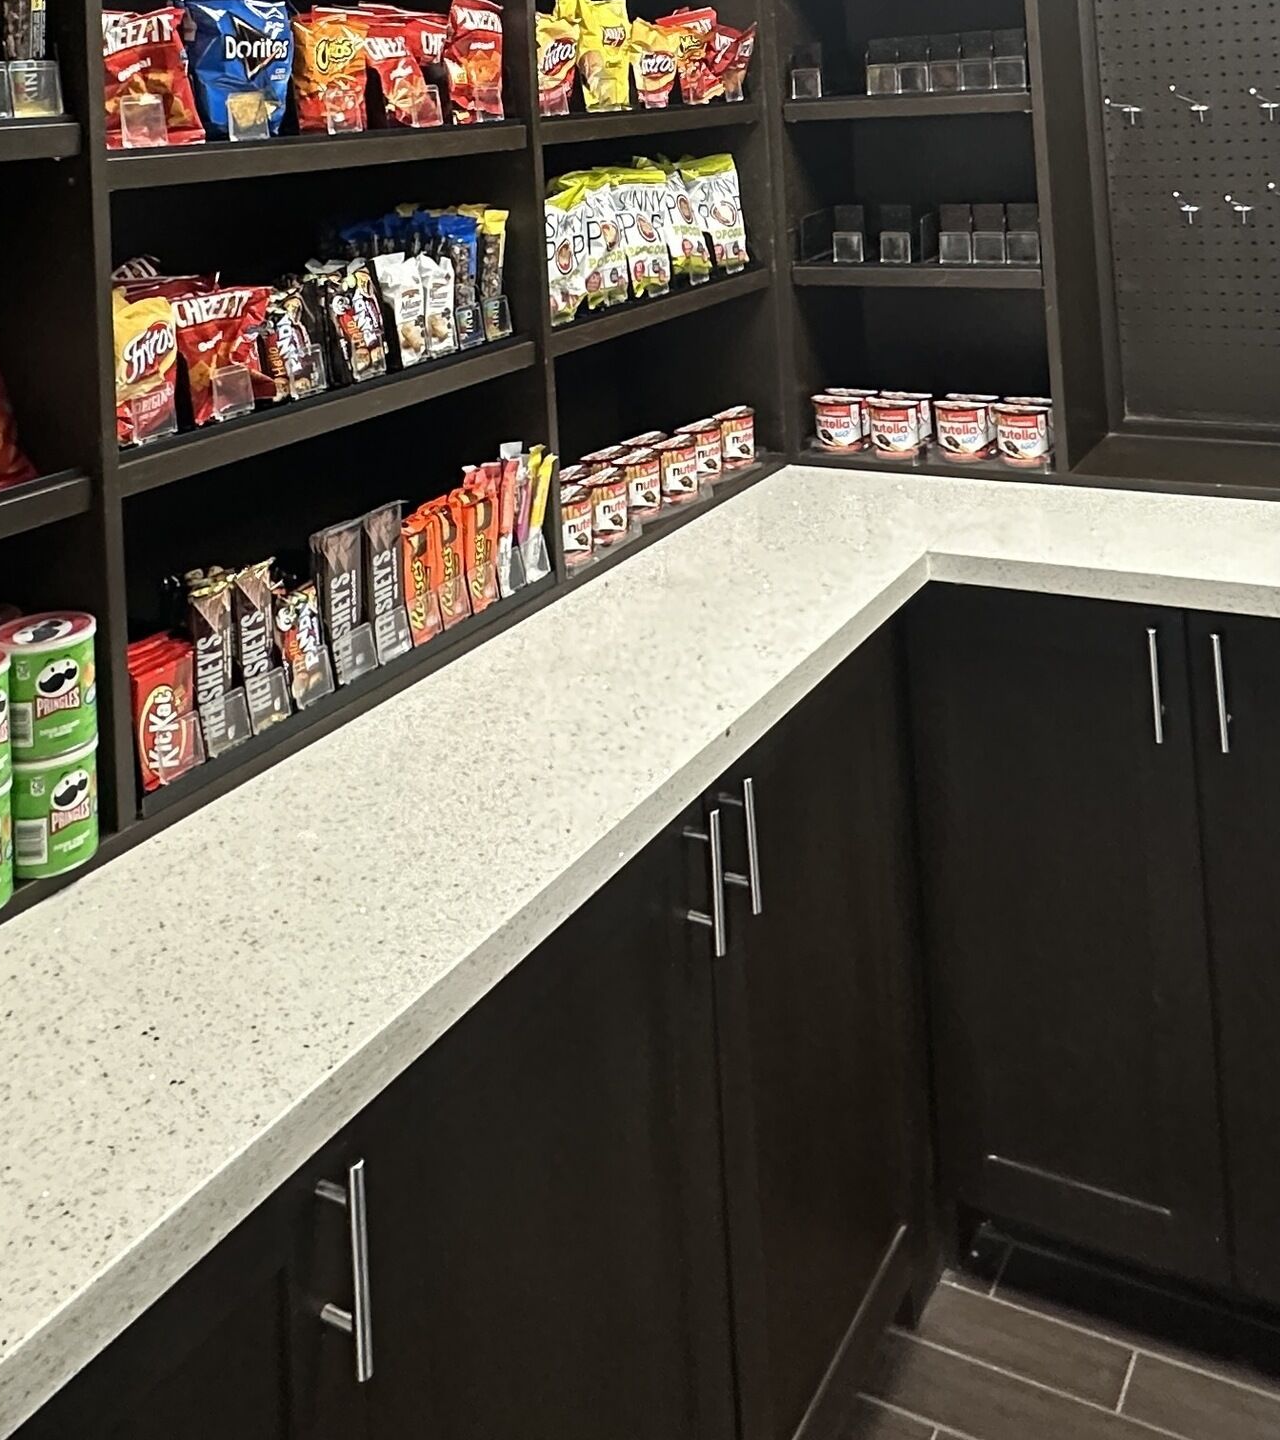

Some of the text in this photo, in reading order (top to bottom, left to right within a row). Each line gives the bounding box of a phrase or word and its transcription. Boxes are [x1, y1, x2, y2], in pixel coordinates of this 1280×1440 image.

[225, 36, 289, 60] Doritos
[352, 288, 380, 348] PANDA
[124, 325, 175, 385] Fritos
[276, 313, 303, 373] PANDA
[872, 422, 908, 434] nutella
[940, 424, 978, 436] nutella
[999, 429, 1038, 442] nutella
[296, 601, 320, 671] PANDA
[37, 687, 80, 719] PRINGLES
[51, 797, 91, 833] PRINGLES
